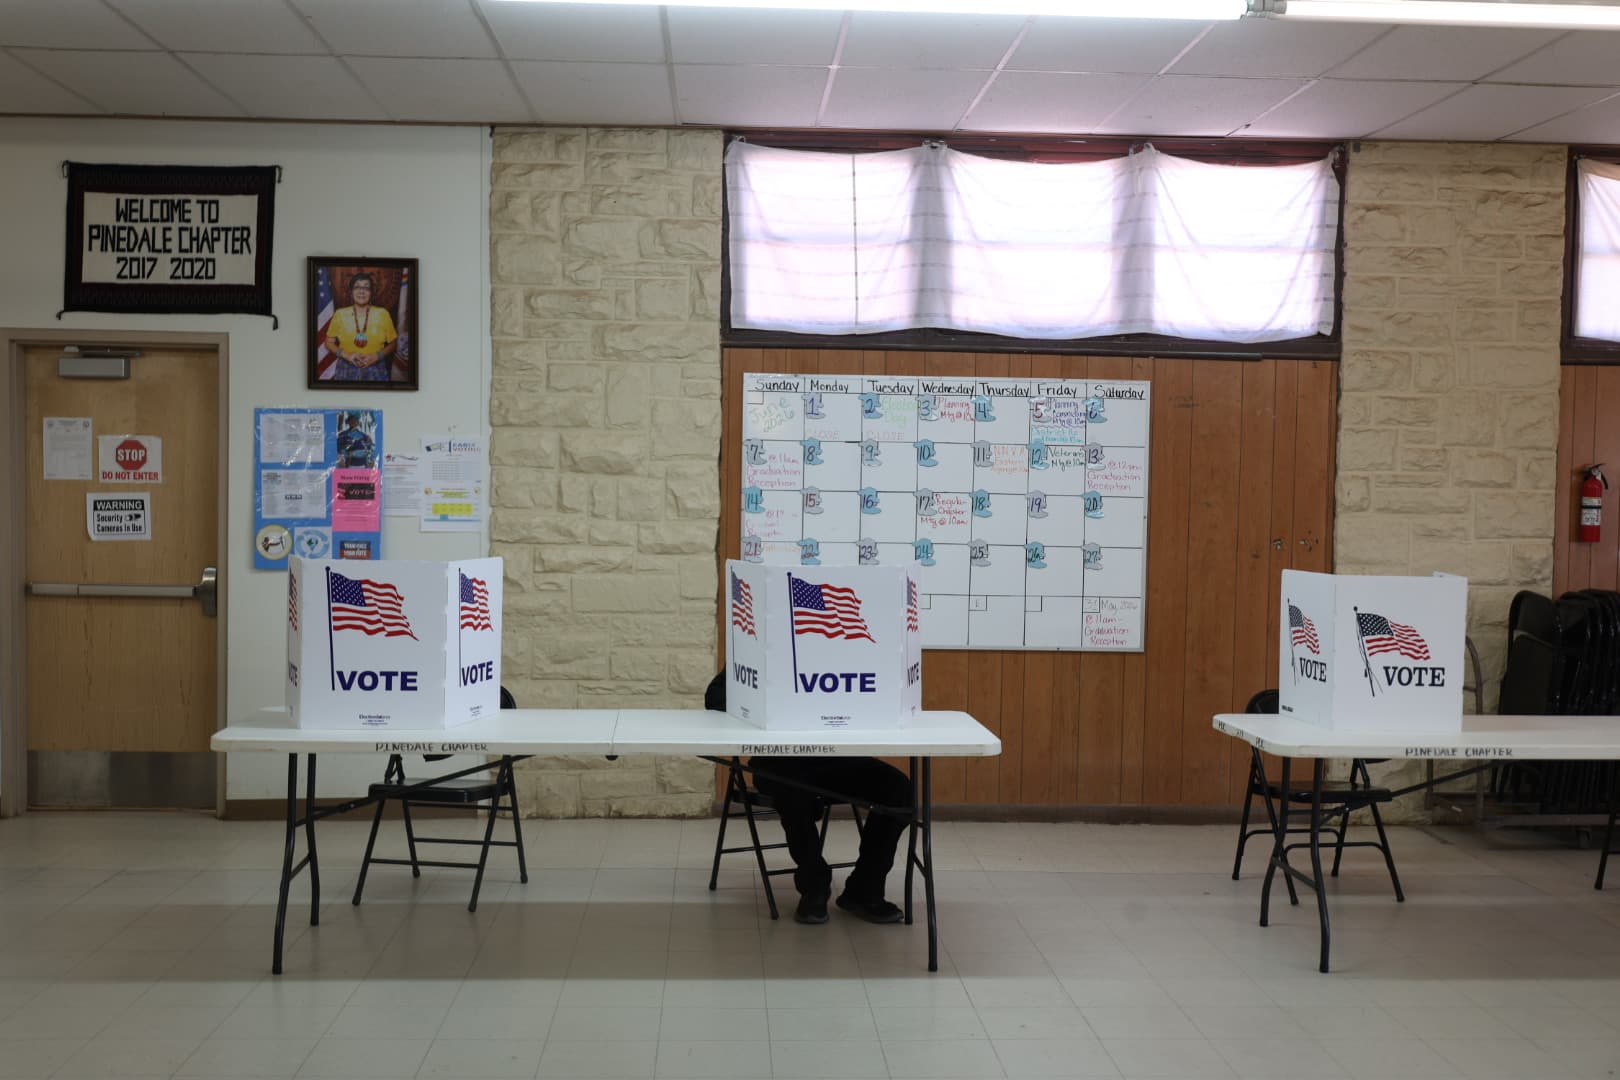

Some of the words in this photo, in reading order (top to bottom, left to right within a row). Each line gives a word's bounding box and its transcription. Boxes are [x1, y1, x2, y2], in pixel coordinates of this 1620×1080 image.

[116, 198, 192, 223] WELCOME
[196, 199, 220, 224] TO
[88, 224, 172, 254] PINEDALE
[178, 226, 252, 255] CHAPTER
[116, 256, 158, 280] 2017
[170, 257, 216, 280] 2020
[754, 380, 800, 393] Sunday
[810, 380, 849, 394] Monday
[867, 380, 914, 395] Tuesday
[922, 382, 975, 399] Wednesday
[978, 382, 1030, 397] Thursday
[1038, 382, 1077, 398] Friday
[1094, 384, 1144, 400] Saturday
[808, 397, 819, 416] 1
[864, 398, 874, 414] 2
[920, 400, 931, 416] 3
[978, 402, 986, 419] 4
[1034, 402, 1044, 419] 5
[118, 448, 146, 461] STOP
[750, 444, 758, 461] 7
[807, 445, 816, 462] 8
[866, 444, 874, 462] 9
[920, 445, 930, 461] 10
[977, 448, 986, 462] 11
[1032, 450, 1042, 466] 12
[1088, 448, 1098, 464] 13
[102, 472, 113, 480] DO
[116, 472, 130, 480] NOT
[133, 472, 158, 480] ENTER
[96, 501, 142, 510] WARNING
[747, 492, 758, 511] 14
[805, 493, 816, 508] 15
[863, 494, 874, 509] 16
[920, 496, 930, 511] 17
[974, 496, 986, 511] 18
[1030, 497, 1041, 513] 19
[1086, 498, 1098, 512] 20
[96, 514, 123, 524] Security
[96, 524, 122, 533] Cameras
[132, 524, 142, 532] Use
[744, 541, 758, 557] 21
[860, 545, 873, 560] 23
[916, 545, 930, 560] 24
[972, 546, 984, 560] 25
[1084, 550, 1098, 564] 27
[462, 660, 494, 686] VOTE
[734, 662, 758, 690] VOTE
[906, 662, 920, 689] VOTE
[1299, 656, 1327, 683] VOTE
[1383, 666, 1446, 688] VOTE
[336, 670, 418, 692] VOTE
[798, 672, 876, 693] VOTE
[375, 742, 434, 752] PINEDALE
[441, 742, 488, 752] CHAPTER
[742, 744, 790, 754] PINEDALE
[792, 744, 836, 754] CHAPTER
[1404, 746, 1458, 758] PINEDALE
[1464, 746, 1513, 758] CHAPTER
